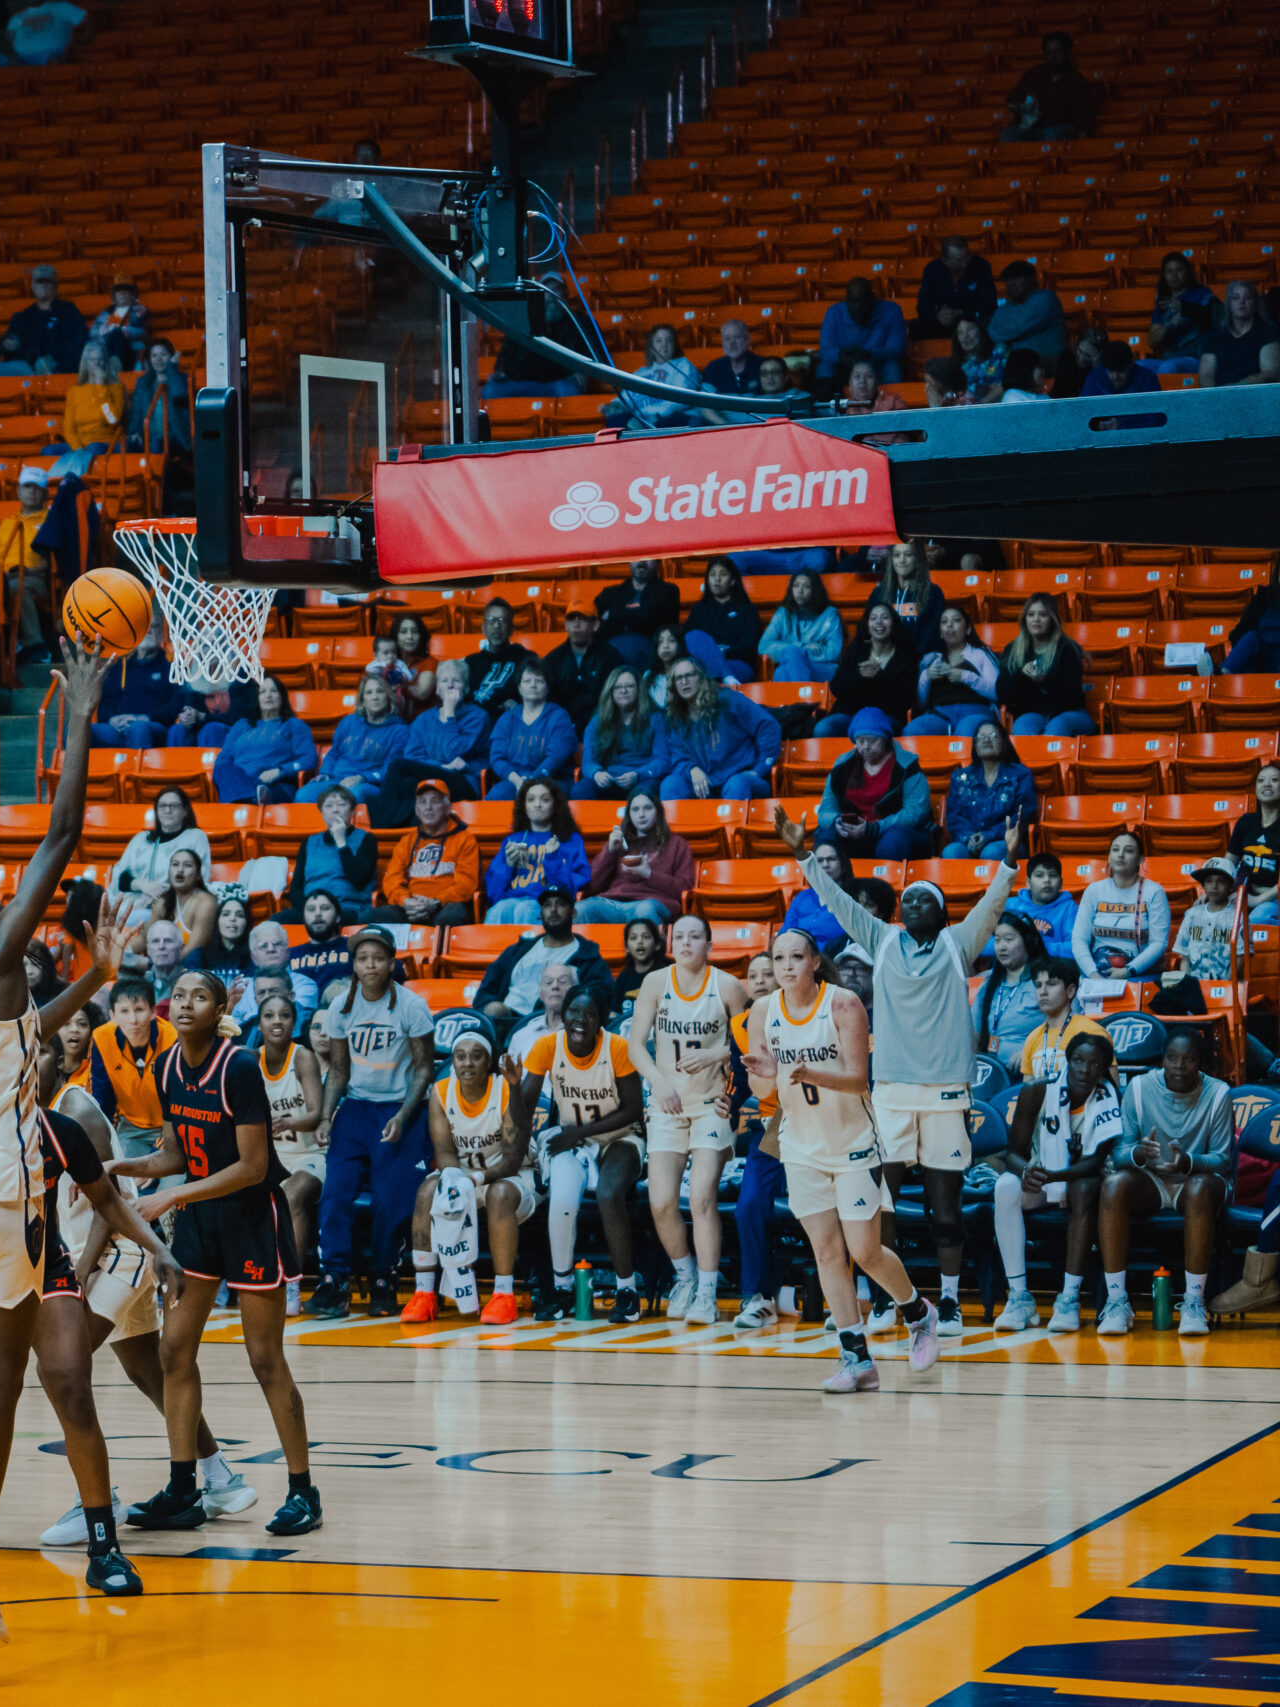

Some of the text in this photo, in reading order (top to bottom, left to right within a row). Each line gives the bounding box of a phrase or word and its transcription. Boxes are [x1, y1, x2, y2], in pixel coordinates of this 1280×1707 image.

[658, 1017, 719, 1035] MINEROS
[350, 1021, 397, 1057] UTEP
[672, 1038, 702, 1072] 1
[270, 1094, 304, 1111] EROS
[170, 1103, 222, 1124] AM HOUSTON
[177, 1123, 209, 1178] 15
[438, 1240, 470, 1257] RADE
